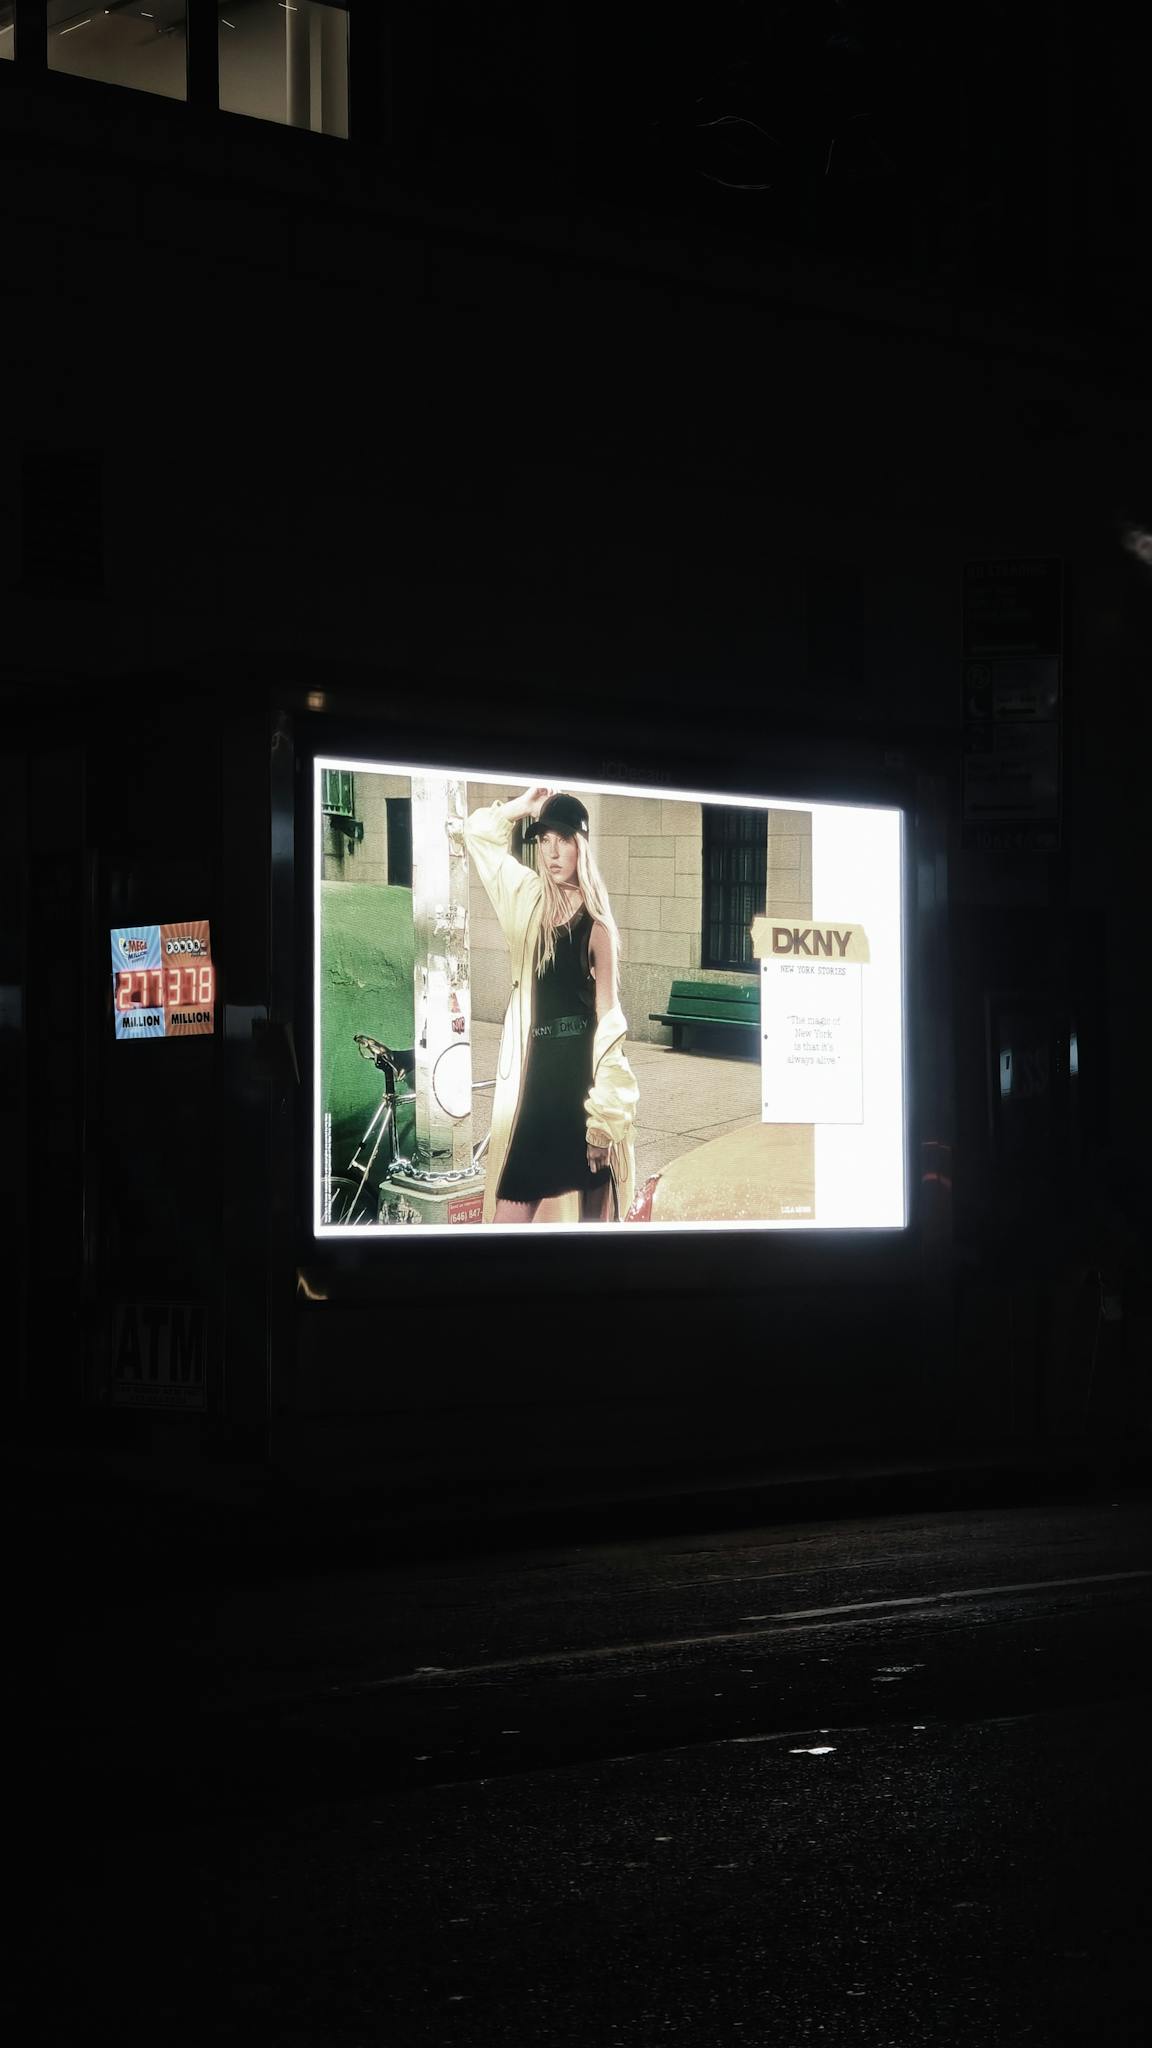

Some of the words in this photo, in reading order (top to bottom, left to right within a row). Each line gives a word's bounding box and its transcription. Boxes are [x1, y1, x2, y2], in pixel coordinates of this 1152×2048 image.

[128, 940, 148, 953] MEGA
[772, 927, 853, 957] DKNY
[780, 965, 795, 974] NEW
[797, 965, 815, 975] YORK
[817, 966, 847, 976] STORIES
[119, 970, 162, 1009] 277
[168, 966, 212, 1006] 378
[122, 1015, 160, 1029] MILLION
[171, 1011, 210, 1025] MILLION
[112, 1306, 203, 1382] ATM
